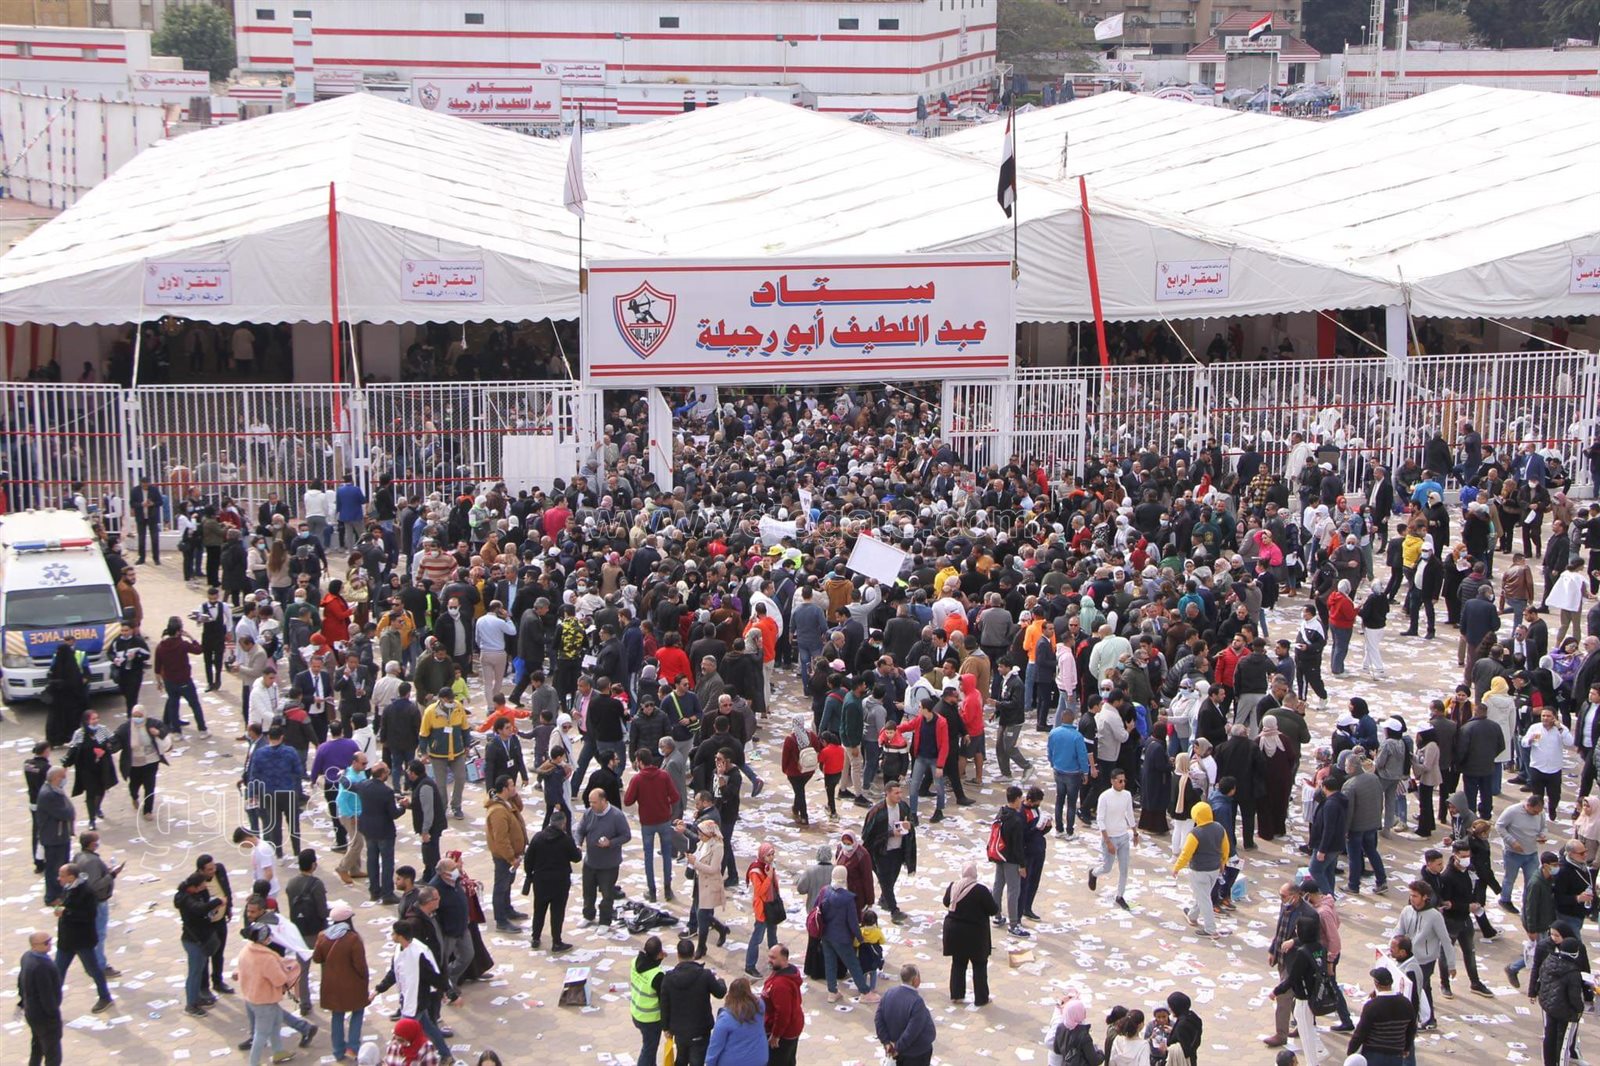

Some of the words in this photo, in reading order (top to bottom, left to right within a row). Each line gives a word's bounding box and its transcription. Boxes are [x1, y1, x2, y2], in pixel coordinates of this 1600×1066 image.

[467, 82, 533, 94] ستاد
[447, 97, 478, 112] رجيلة
[479, 95, 494, 112] أبو
[495, 97, 532, 112] اللطيف
[533, 100, 552, 113] عبد
[185, 275, 222, 291] المقر
[442, 273, 477, 288] المقر
[1166, 274, 1190, 289] الرابع
[1192, 272, 1222, 287] المقر
[750, 274, 936, 307] ستاد
[696, 317, 779, 358] رجيلة
[780, 308, 825, 357] أبو
[830, 314, 930, 355] اللطيف
[935, 317, 988, 352] عبد
